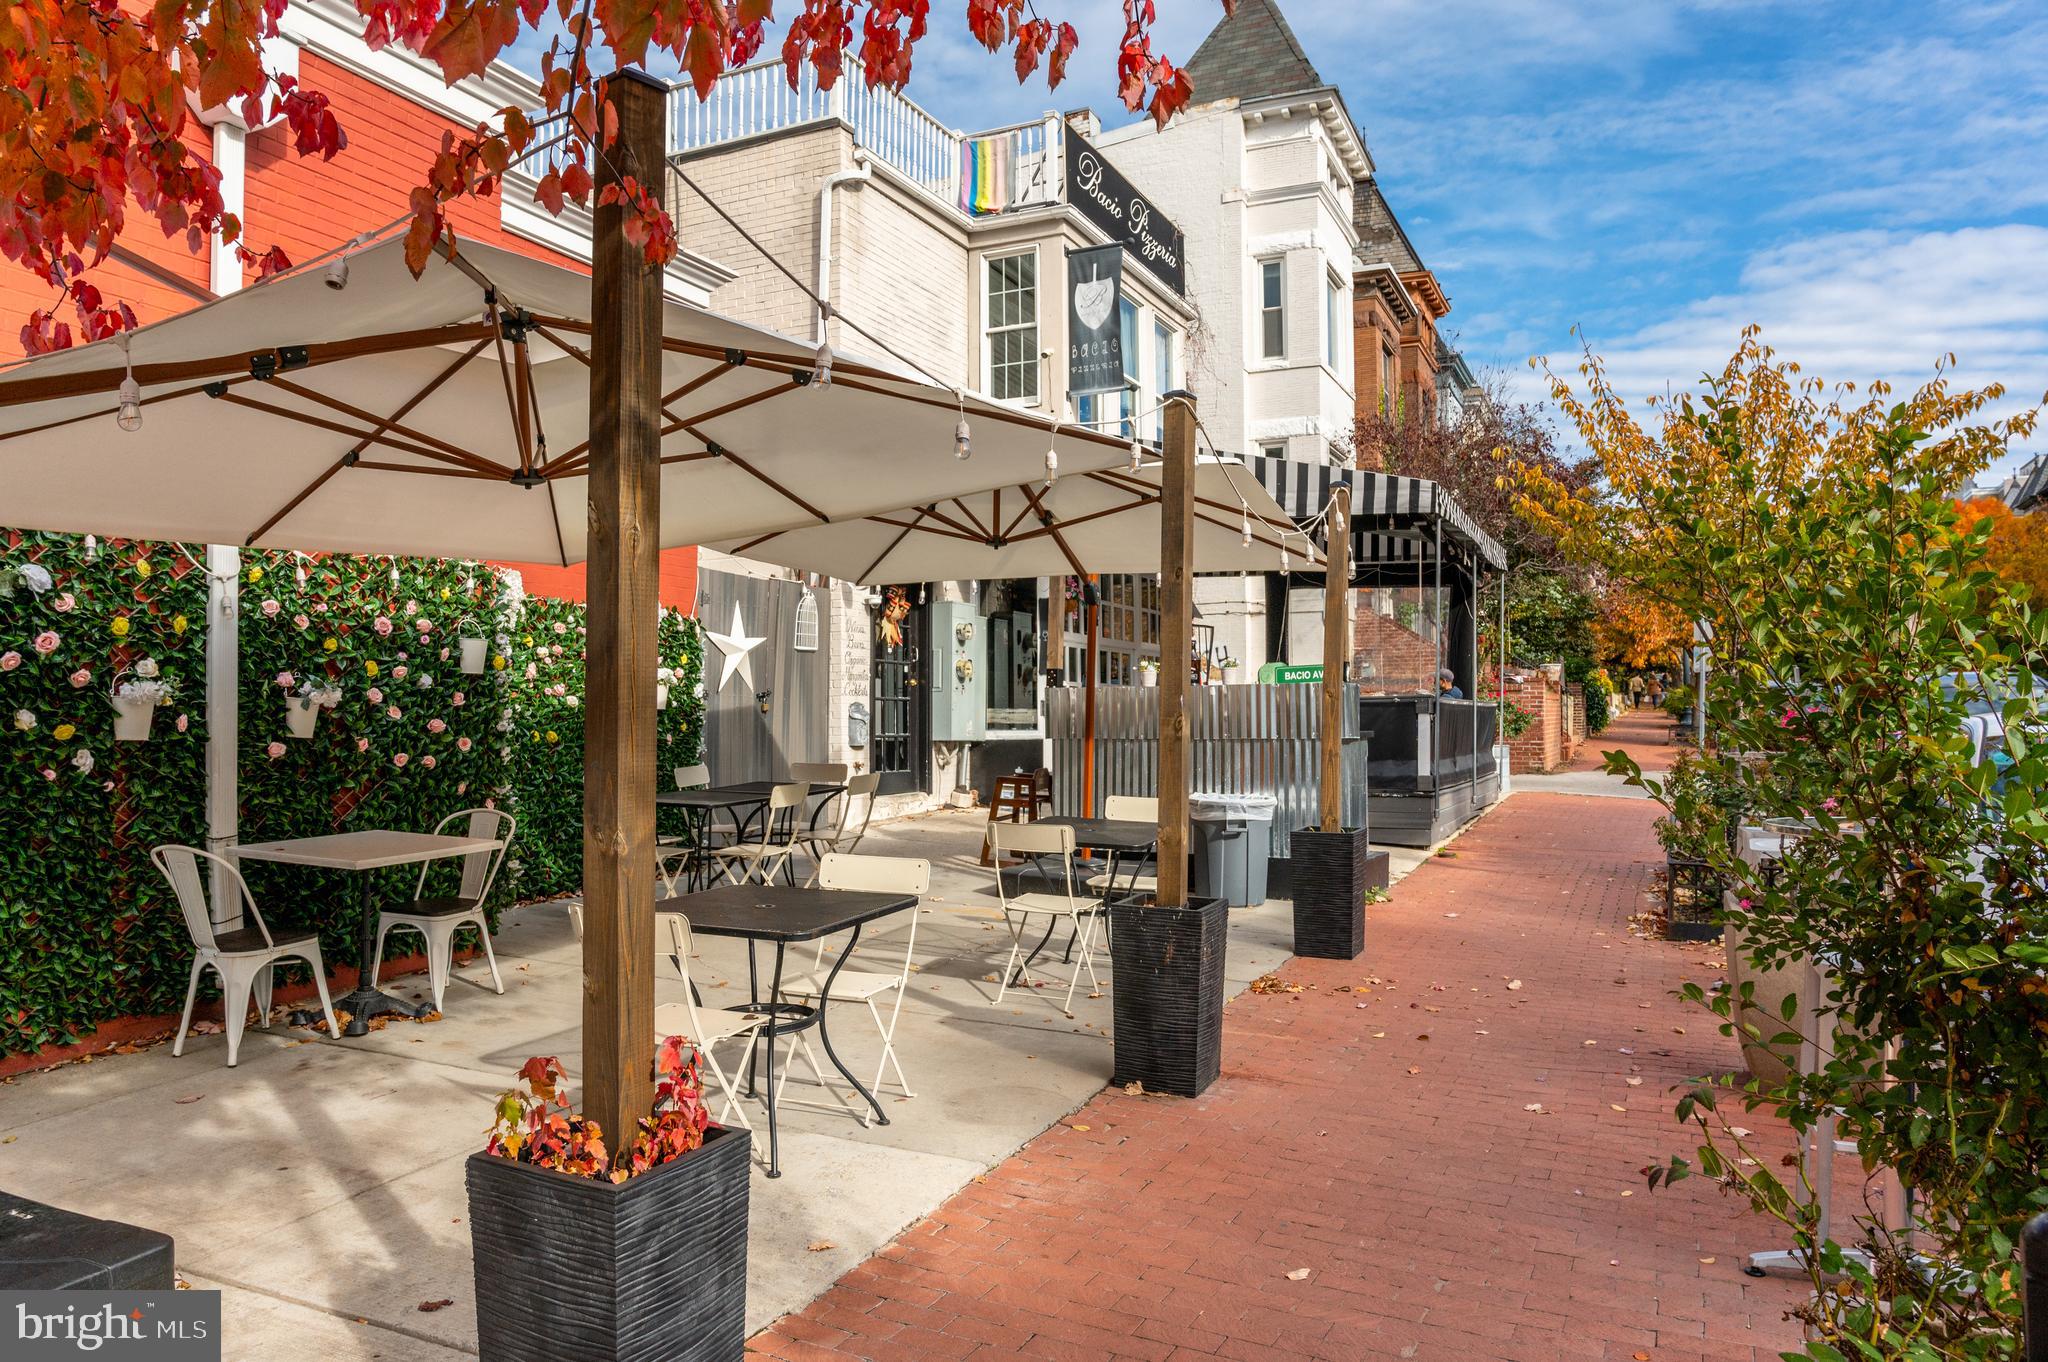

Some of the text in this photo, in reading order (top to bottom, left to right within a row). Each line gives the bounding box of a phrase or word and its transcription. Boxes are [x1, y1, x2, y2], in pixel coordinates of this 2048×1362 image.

[1076, 151, 1177, 269] Bacio Pizzeria
[1284, 671, 1311, 680] BACIO
